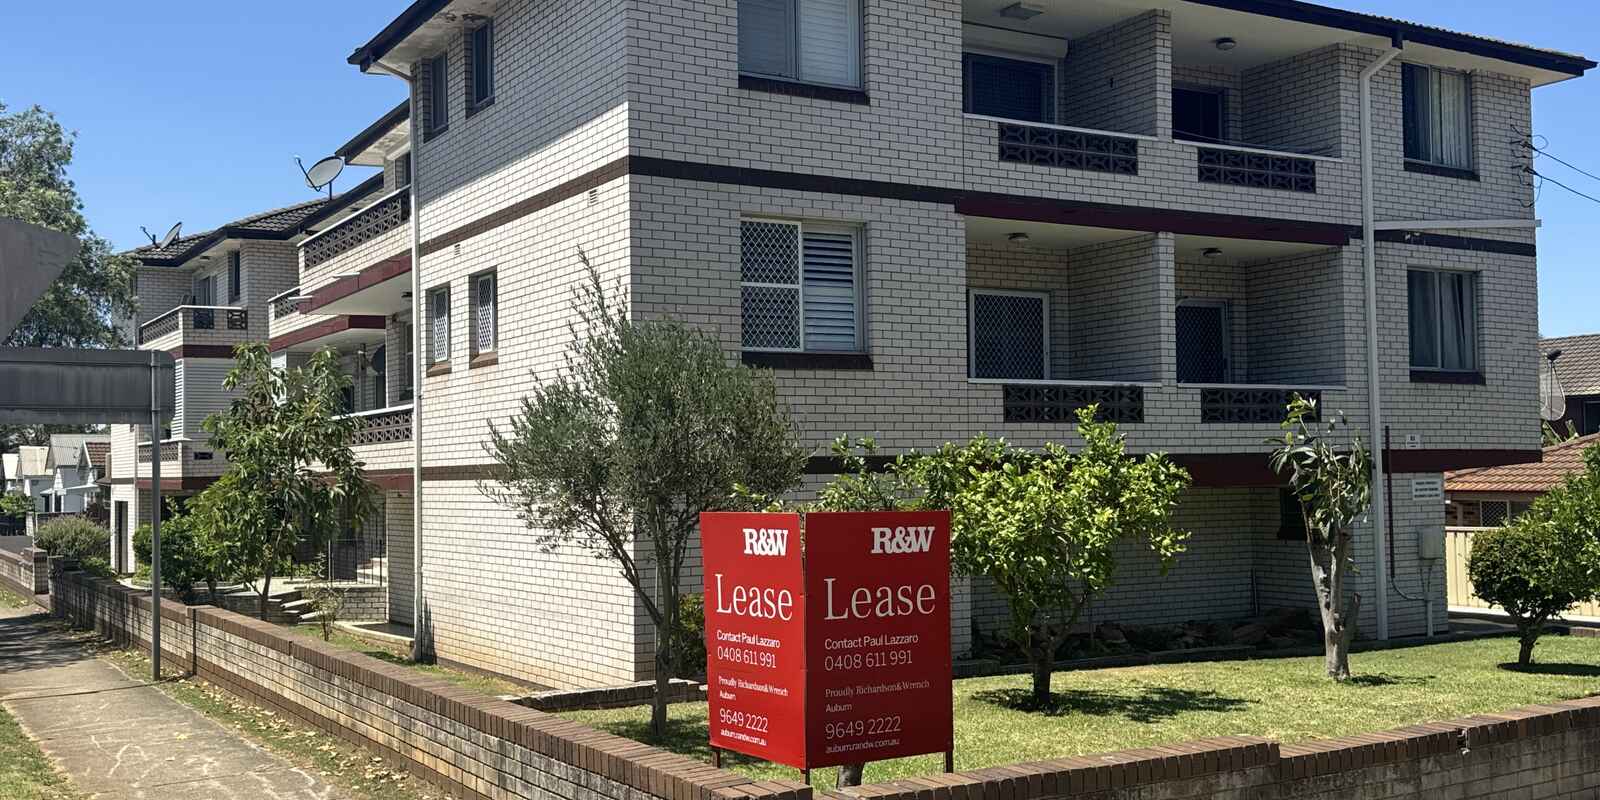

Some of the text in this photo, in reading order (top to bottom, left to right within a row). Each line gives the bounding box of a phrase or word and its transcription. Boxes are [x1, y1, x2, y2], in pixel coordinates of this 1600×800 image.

[742, 528, 788, 556] R&W
[871, 526, 935, 554] R&W
[715, 573, 793, 621] Lease
[823, 578, 936, 620] Lease
[717, 629, 781, 648] Contact Paul Lazzaro
[825, 634, 919, 650] Contact Paul Lazzaro
[717, 646, 776, 668] 0408 611 991
[825, 650, 913, 671] 0408 611 991
[718, 675, 737, 688] Proudly
[825, 686, 854, 698] Proudly
[720, 690, 736, 700] Auburn
[825, 703, 853, 713] Auburn
[720, 708, 768, 733] 9649 2222
[825, 715, 902, 740] 9649 2222
